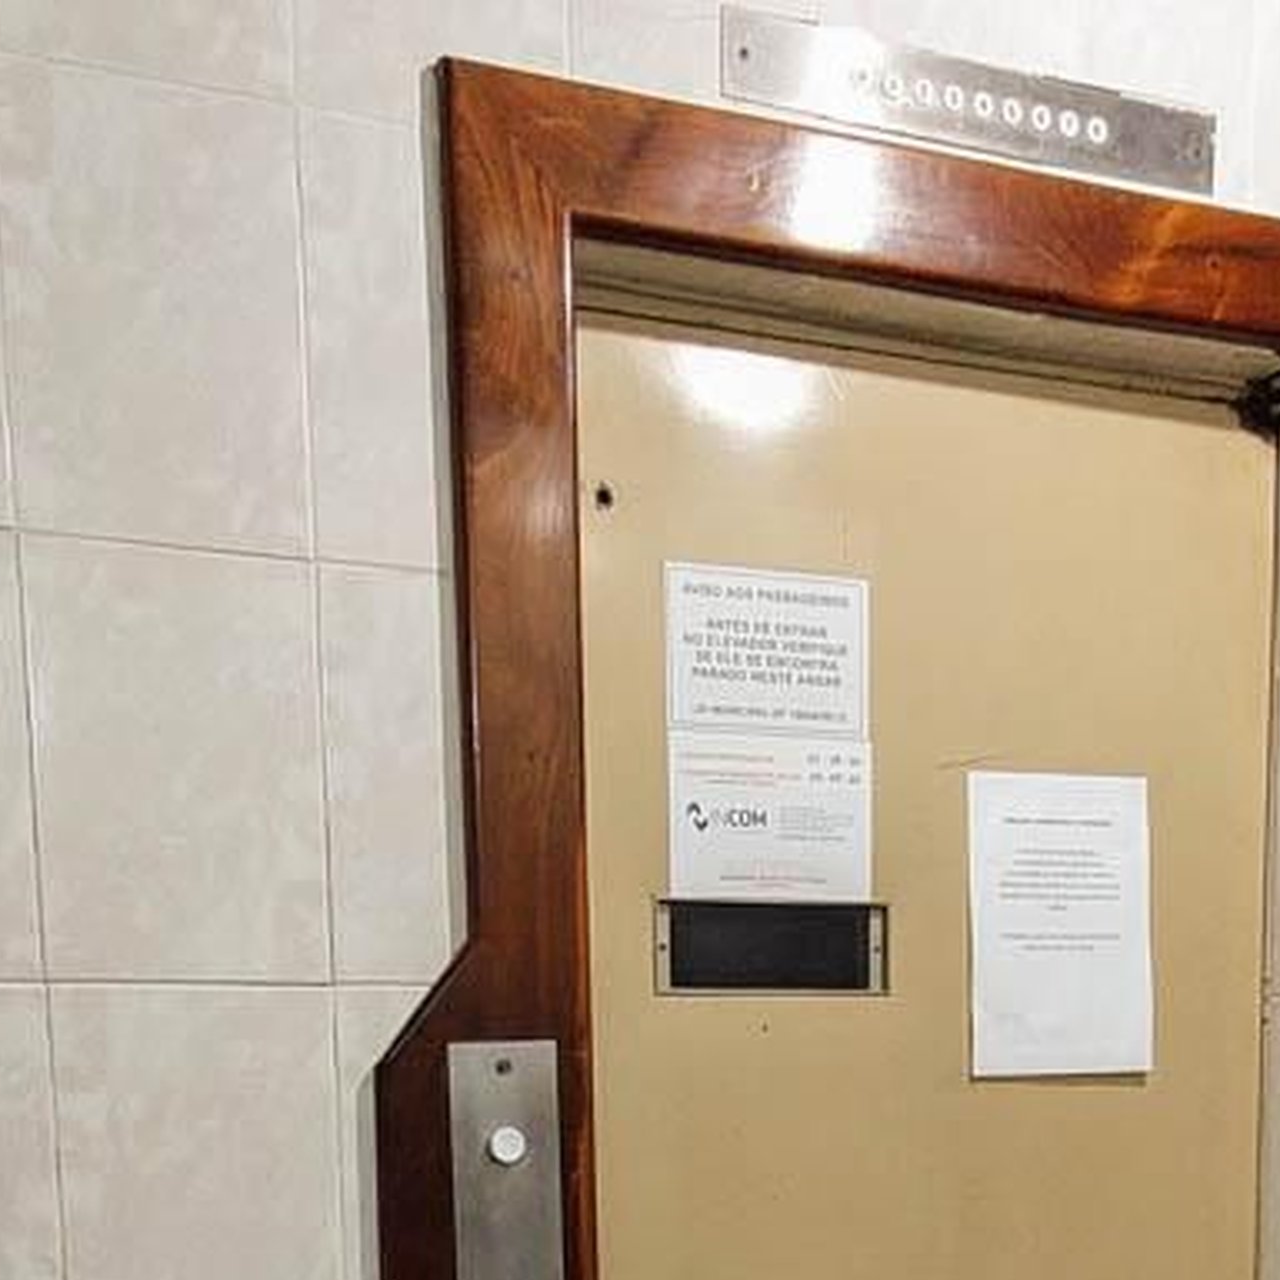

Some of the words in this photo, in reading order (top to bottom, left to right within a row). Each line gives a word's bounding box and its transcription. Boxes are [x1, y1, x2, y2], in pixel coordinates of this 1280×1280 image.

[706, 618, 750, 634] ANTES
[753, 621, 770, 635] DE
[774, 623, 828, 638] ENTRAR
[683, 633, 703, 647] NO
[706, 634, 777, 651] ELEVADOR
[782, 641, 847, 656] VERIFIQUE
[766, 655, 839, 671] ENCONTRA
[692, 666, 747, 681] PARADO
[796, 672, 842, 687] ANDAR
